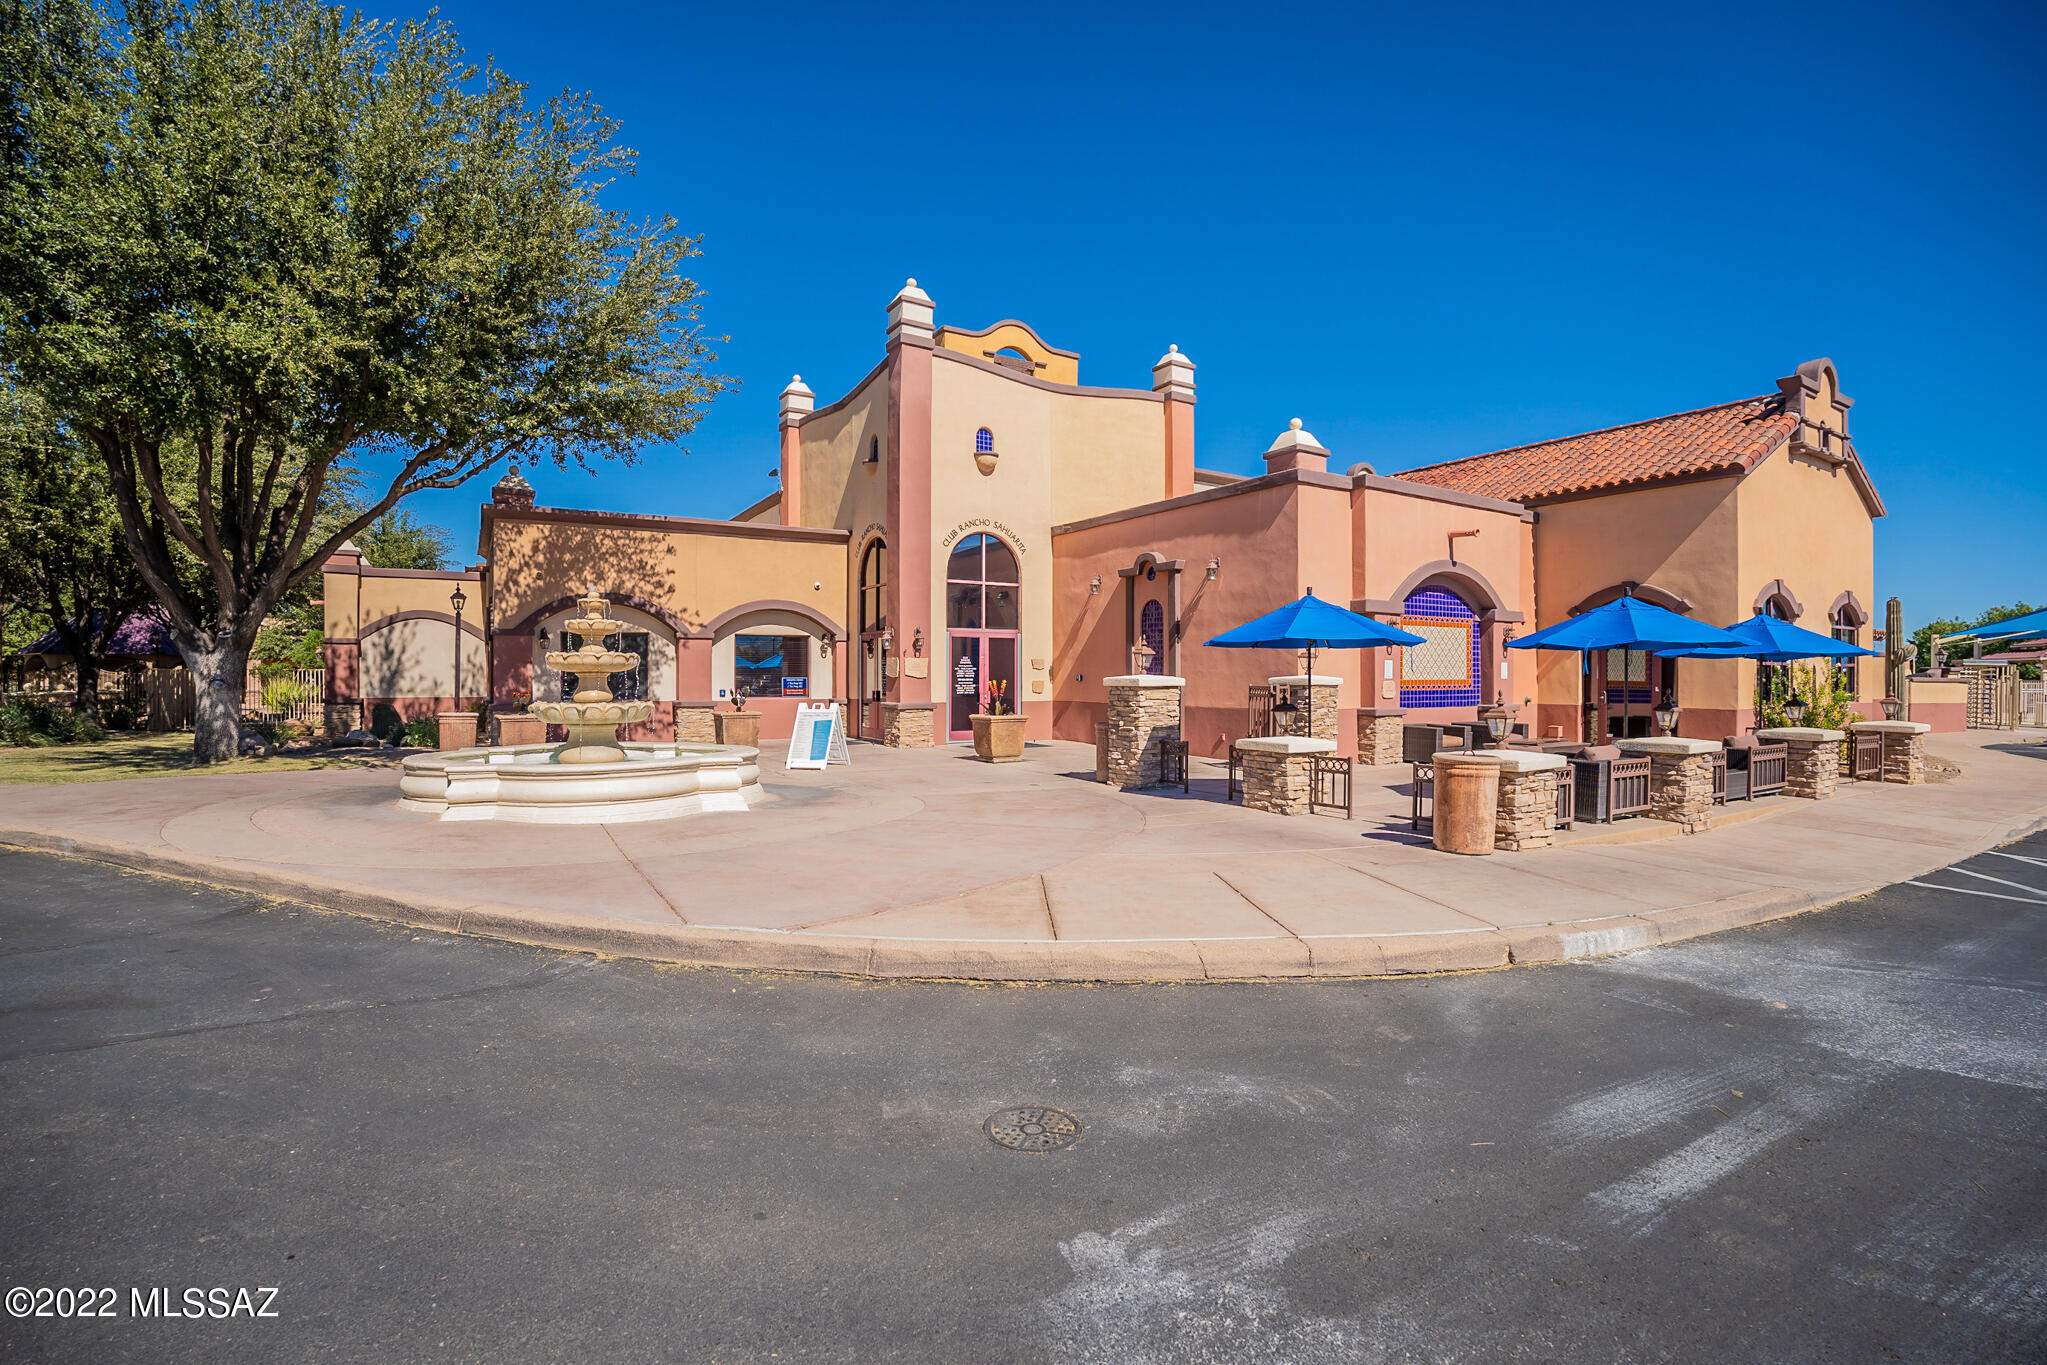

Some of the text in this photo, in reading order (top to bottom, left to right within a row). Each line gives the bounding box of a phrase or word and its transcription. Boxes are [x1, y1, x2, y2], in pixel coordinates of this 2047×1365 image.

[943, 519, 1026, 555] CLUB RANCHO SAHUARITA
